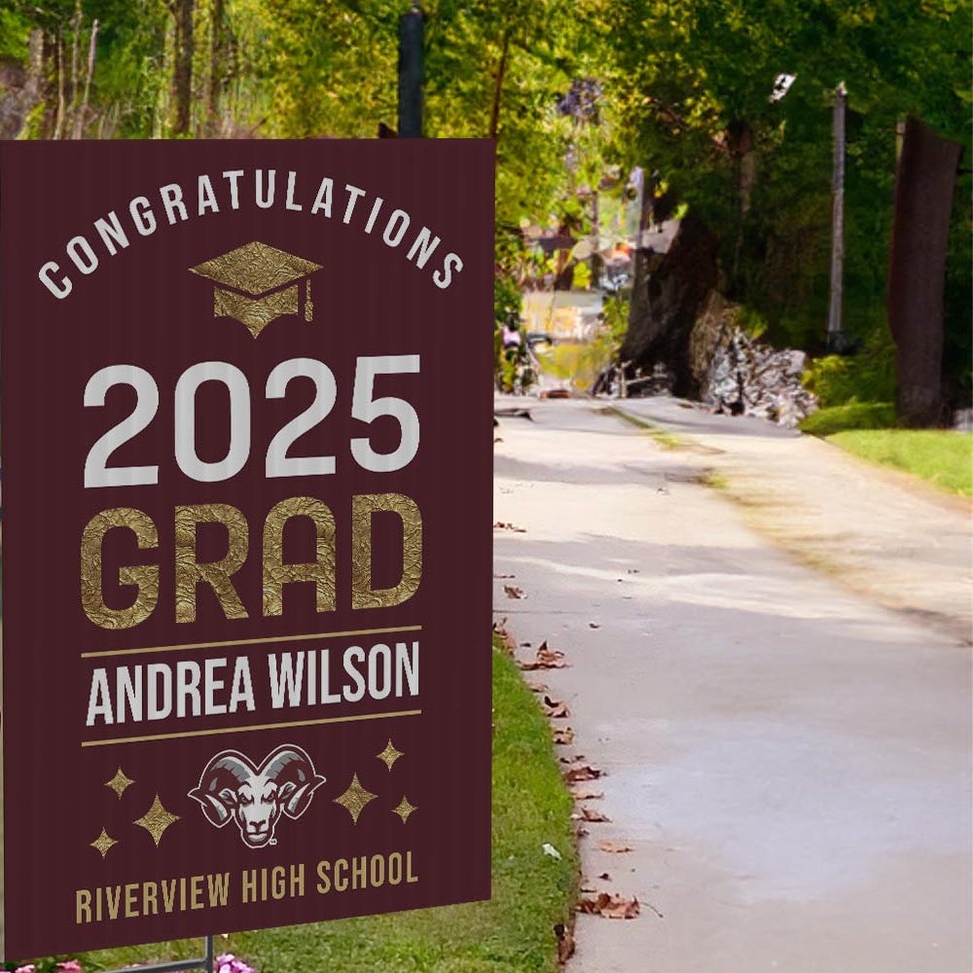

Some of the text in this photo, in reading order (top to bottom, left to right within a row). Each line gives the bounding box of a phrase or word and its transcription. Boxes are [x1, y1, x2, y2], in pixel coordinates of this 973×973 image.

[39, 169, 463, 299] CONGRATULATIONS
[84, 354, 420, 488] 2025
[81, 493, 422, 629] GRAD
[86, 641, 419, 726] ANDREA WILSON
[76, 851, 418, 923] RIVERVIEW HIGH SCHOOL
